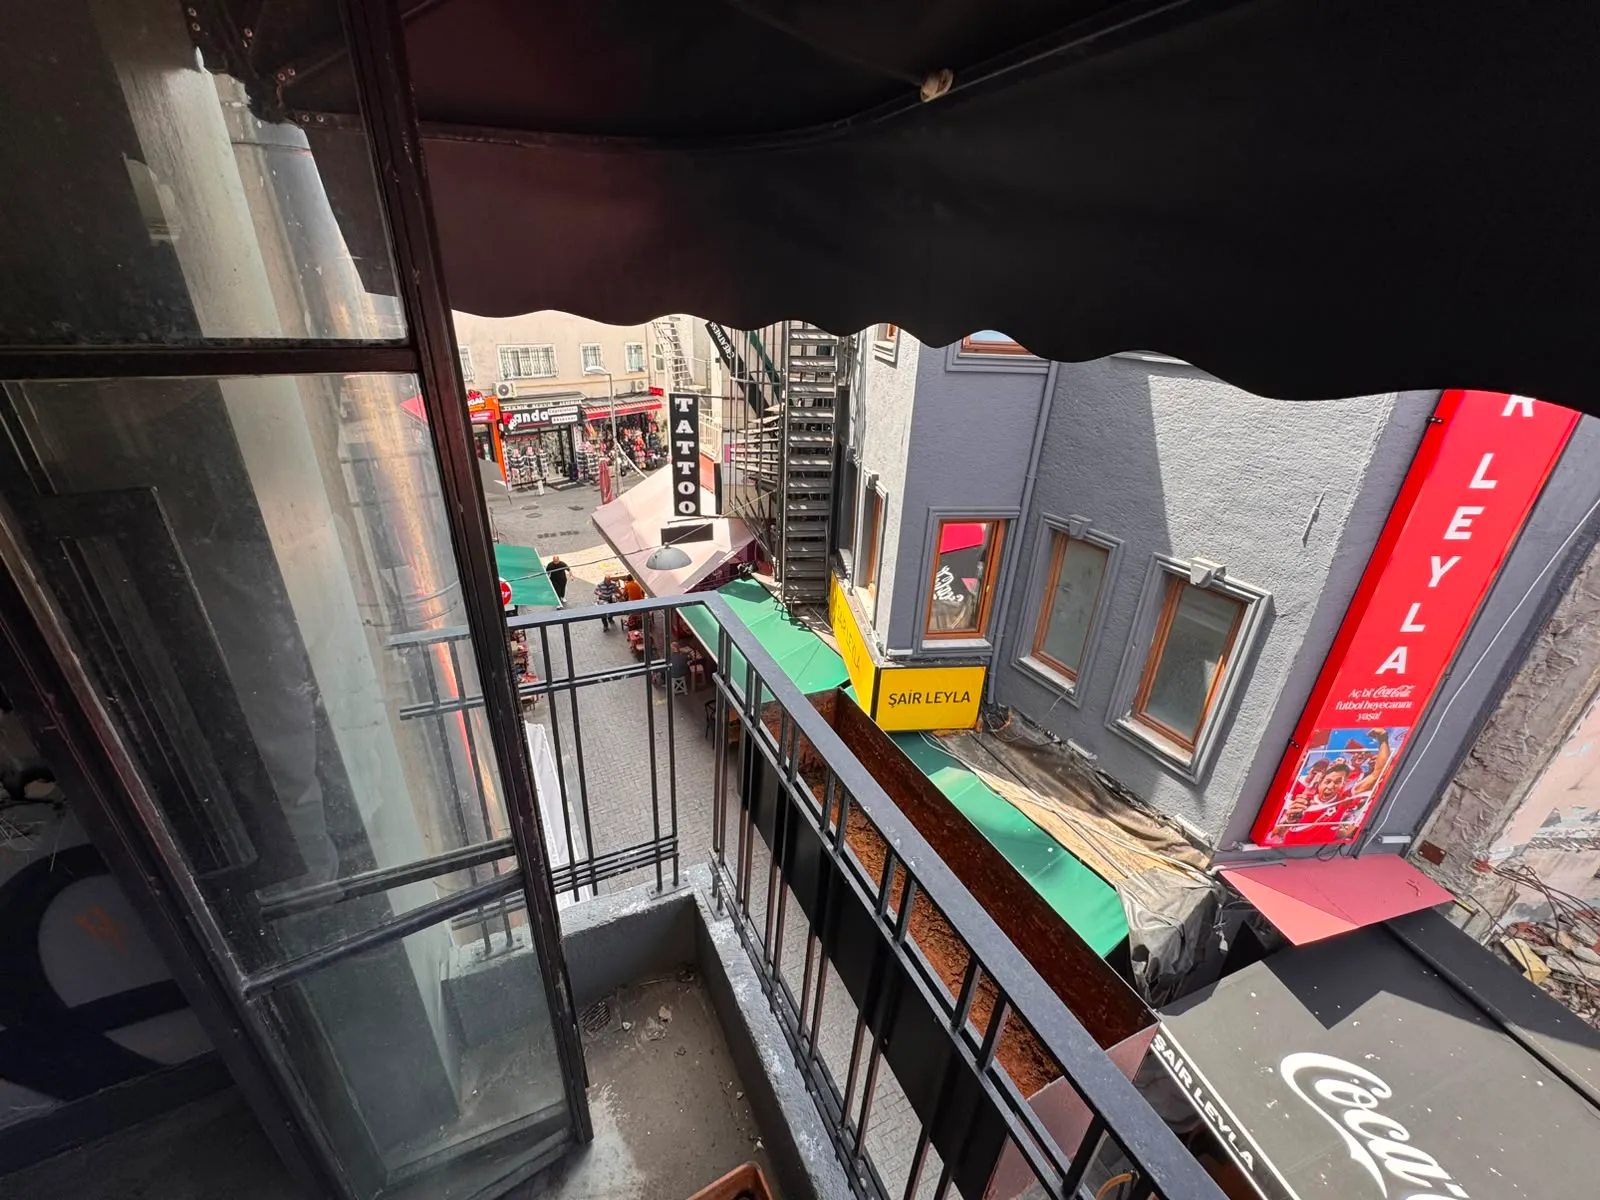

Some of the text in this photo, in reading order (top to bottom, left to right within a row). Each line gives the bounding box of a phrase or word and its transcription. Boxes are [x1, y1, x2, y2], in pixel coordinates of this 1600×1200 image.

[674, 397, 697, 514] TATTOO
[1375, 453, 1498, 675] LEYLA
[888, 689, 971, 708] ŞAİR LEYLA
[1335, 701, 1364, 711] futbol
[1193, 1087, 1255, 1172] LEYLA
